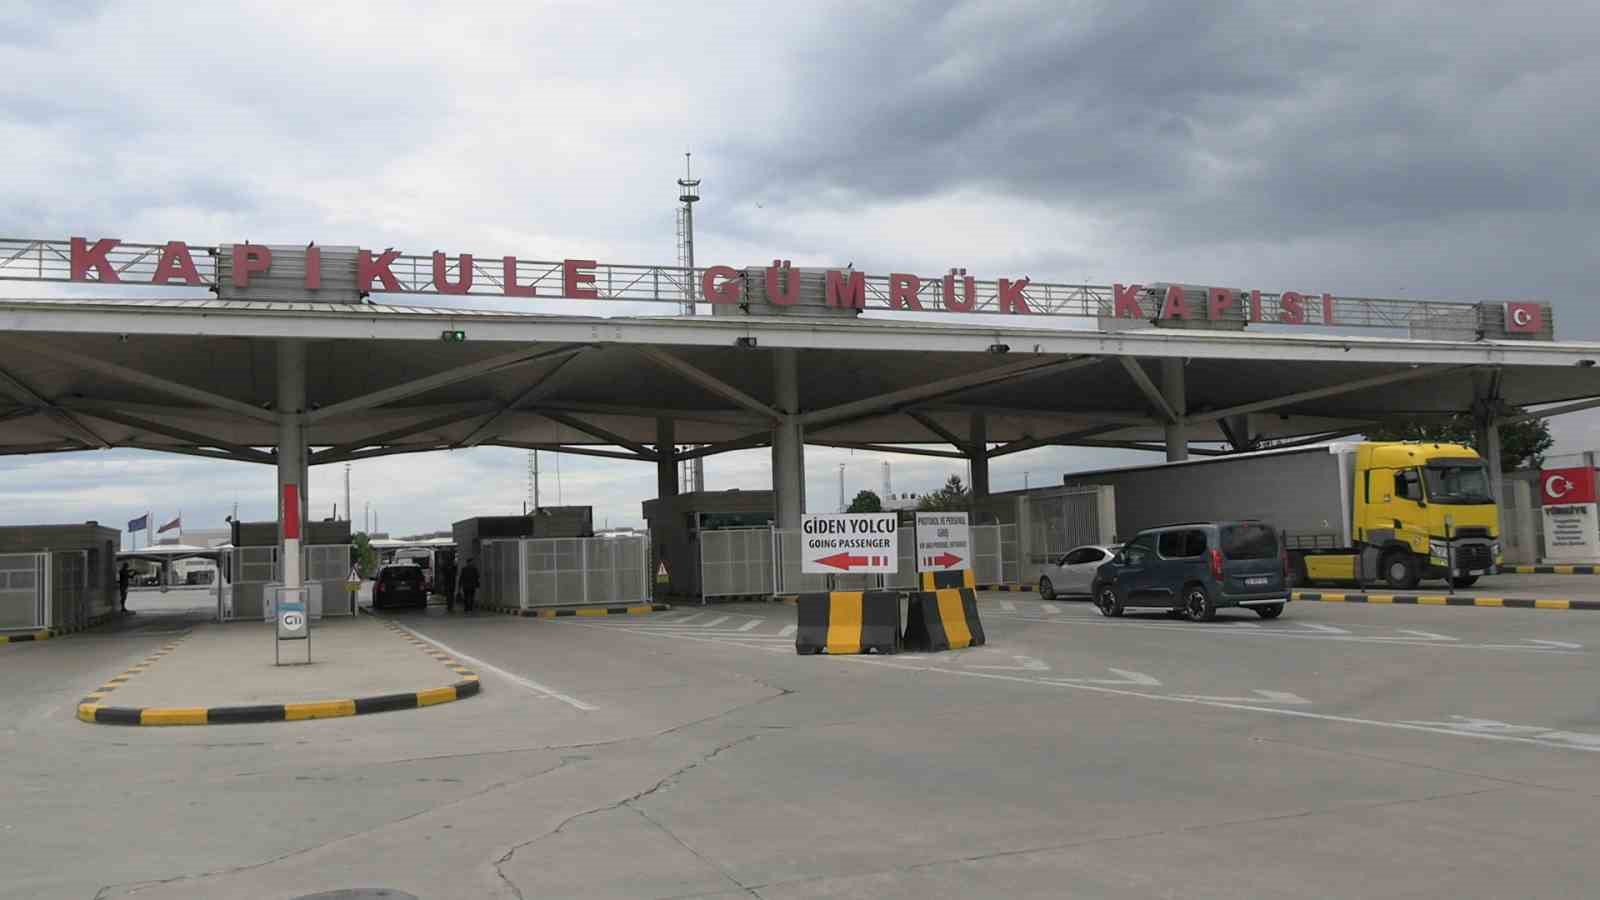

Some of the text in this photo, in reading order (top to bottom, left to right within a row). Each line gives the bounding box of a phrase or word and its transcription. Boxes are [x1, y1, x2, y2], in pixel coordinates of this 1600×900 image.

[703, 259, 1030, 314] GÜMRÜK
[1112, 283, 1335, 326] KAPISI
[803, 516, 895, 534] GİDEN YOLCU
[808, 538, 890, 549] GOING PASSENGER
